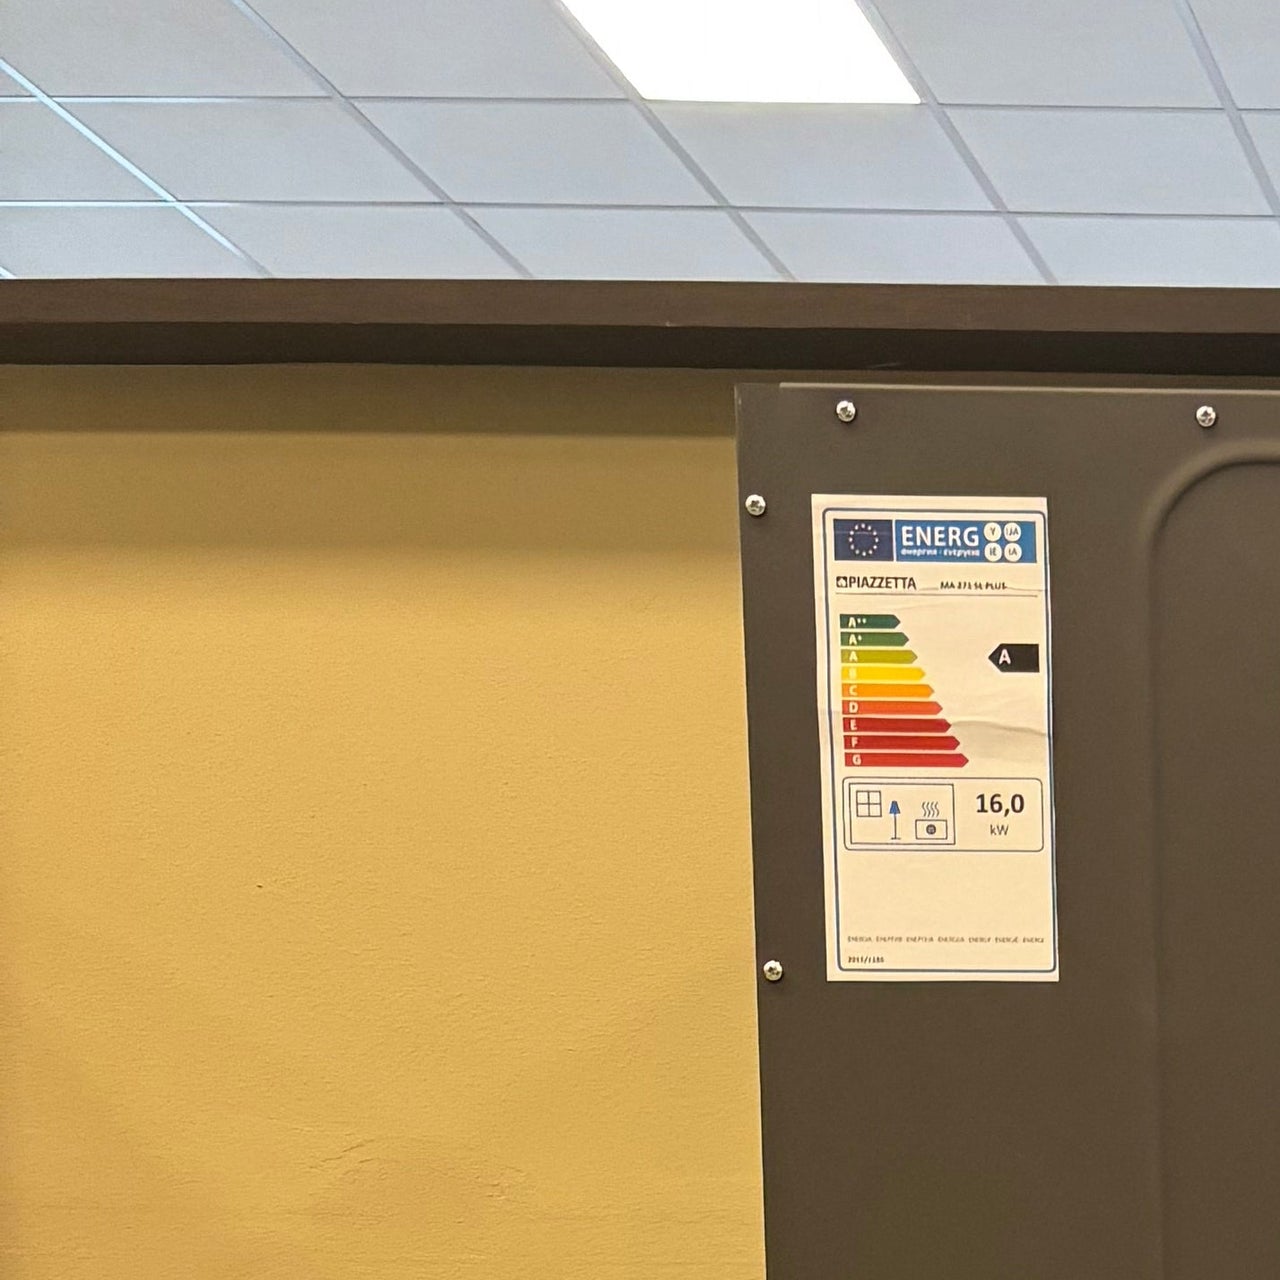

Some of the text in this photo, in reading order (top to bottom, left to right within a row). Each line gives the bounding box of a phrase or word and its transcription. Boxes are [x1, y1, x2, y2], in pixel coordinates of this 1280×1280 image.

[901, 525, 980, 547] ENERG
[989, 527, 996, 536] Y
[849, 576, 917, 590] PIAZZETTA
[849, 651, 858, 662] A
[998, 649, 1011, 665] A
[849, 685, 858, 696] C
[849, 702, 858, 713] D
[850, 719, 858, 730] E
[851, 737, 858, 748] F
[852, 755, 861, 765] G
[976, 793, 1025, 817] 16,0
[990, 824, 1009, 836] kW
